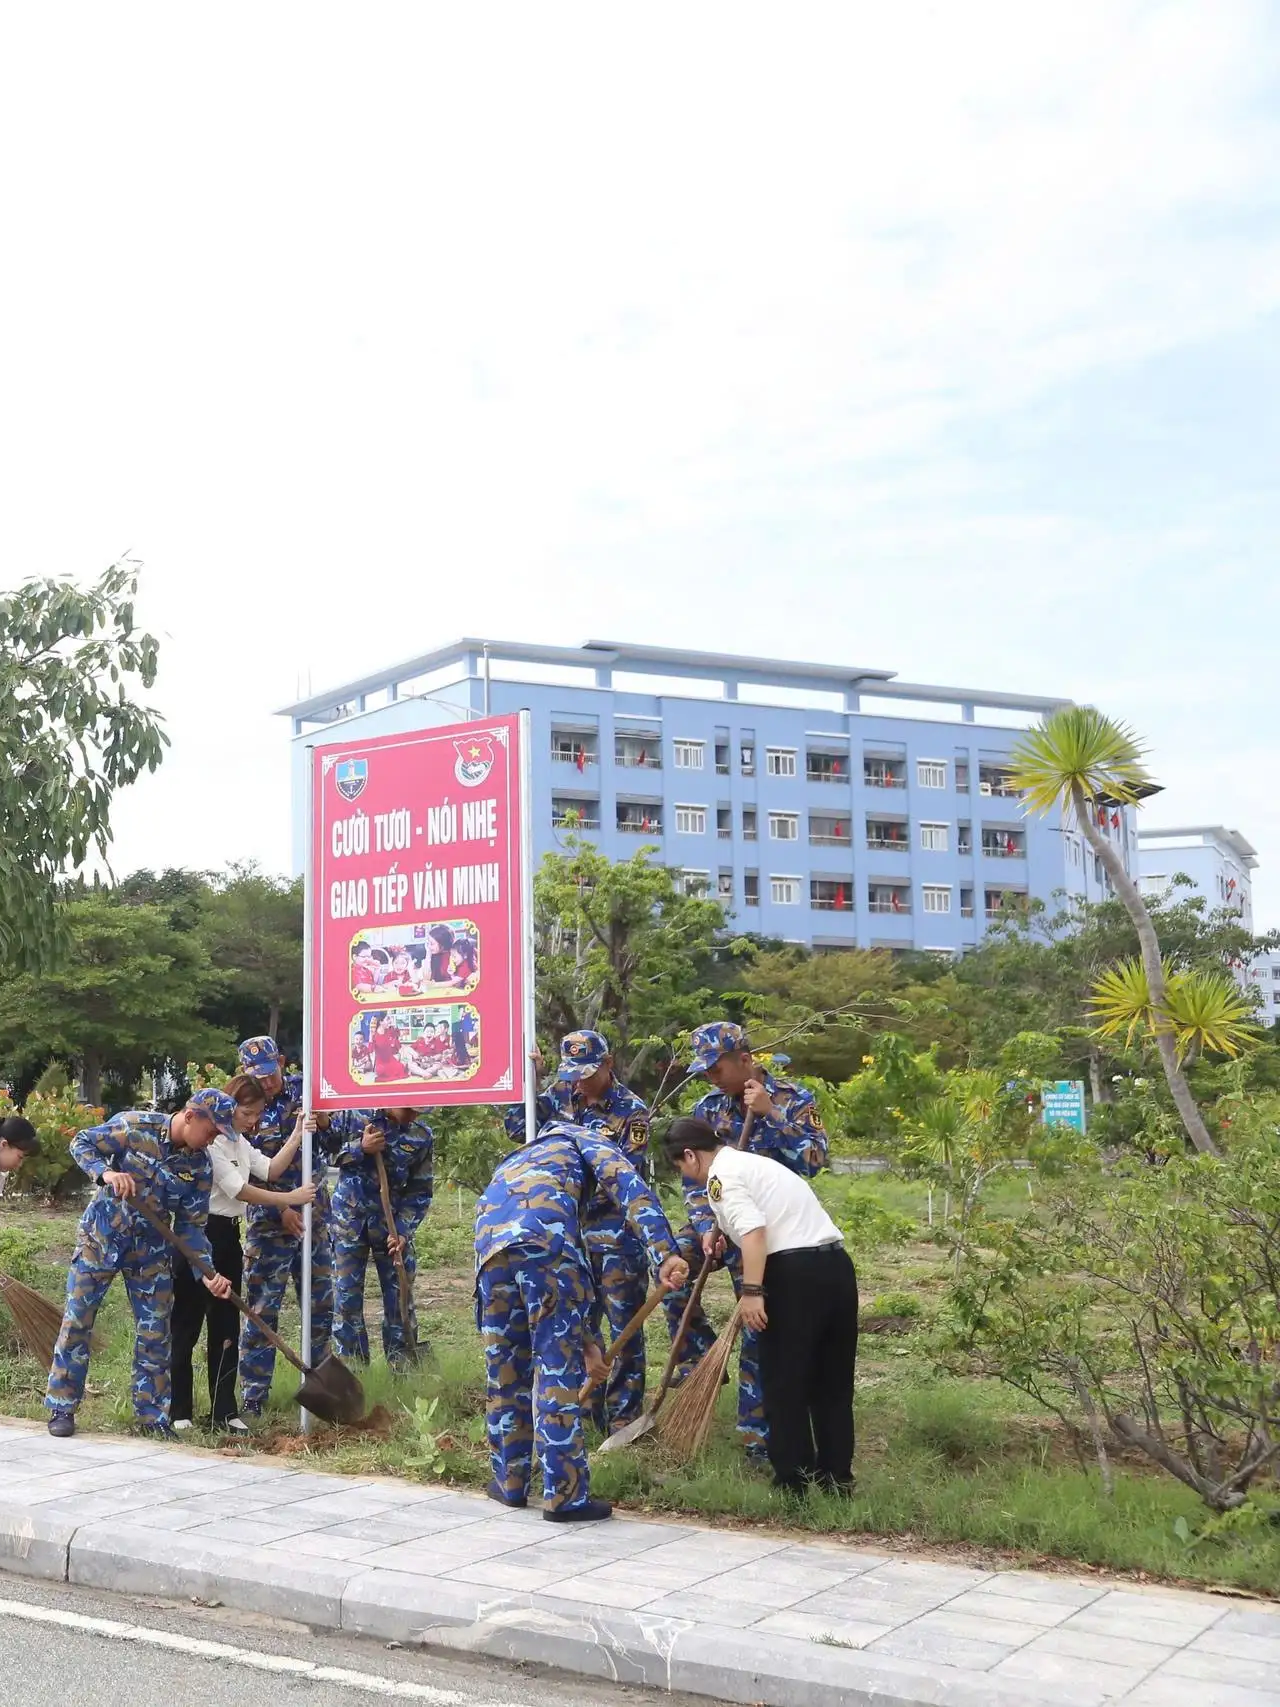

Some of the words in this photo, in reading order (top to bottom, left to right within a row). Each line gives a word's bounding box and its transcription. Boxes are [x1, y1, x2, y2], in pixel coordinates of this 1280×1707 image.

[332, 808, 370, 858] CƯỜI
[374, 808, 411, 852] TƯƠI
[415, 826, 423, 835] -
[427, 796, 457, 845] NÓI
[462, 799, 498, 847] NHẸ
[330, 878, 369, 919] GIAO
[372, 861, 409, 914] TIẾP
[413, 861, 448, 910] VĂN
[452, 862, 499, 906] MINH
